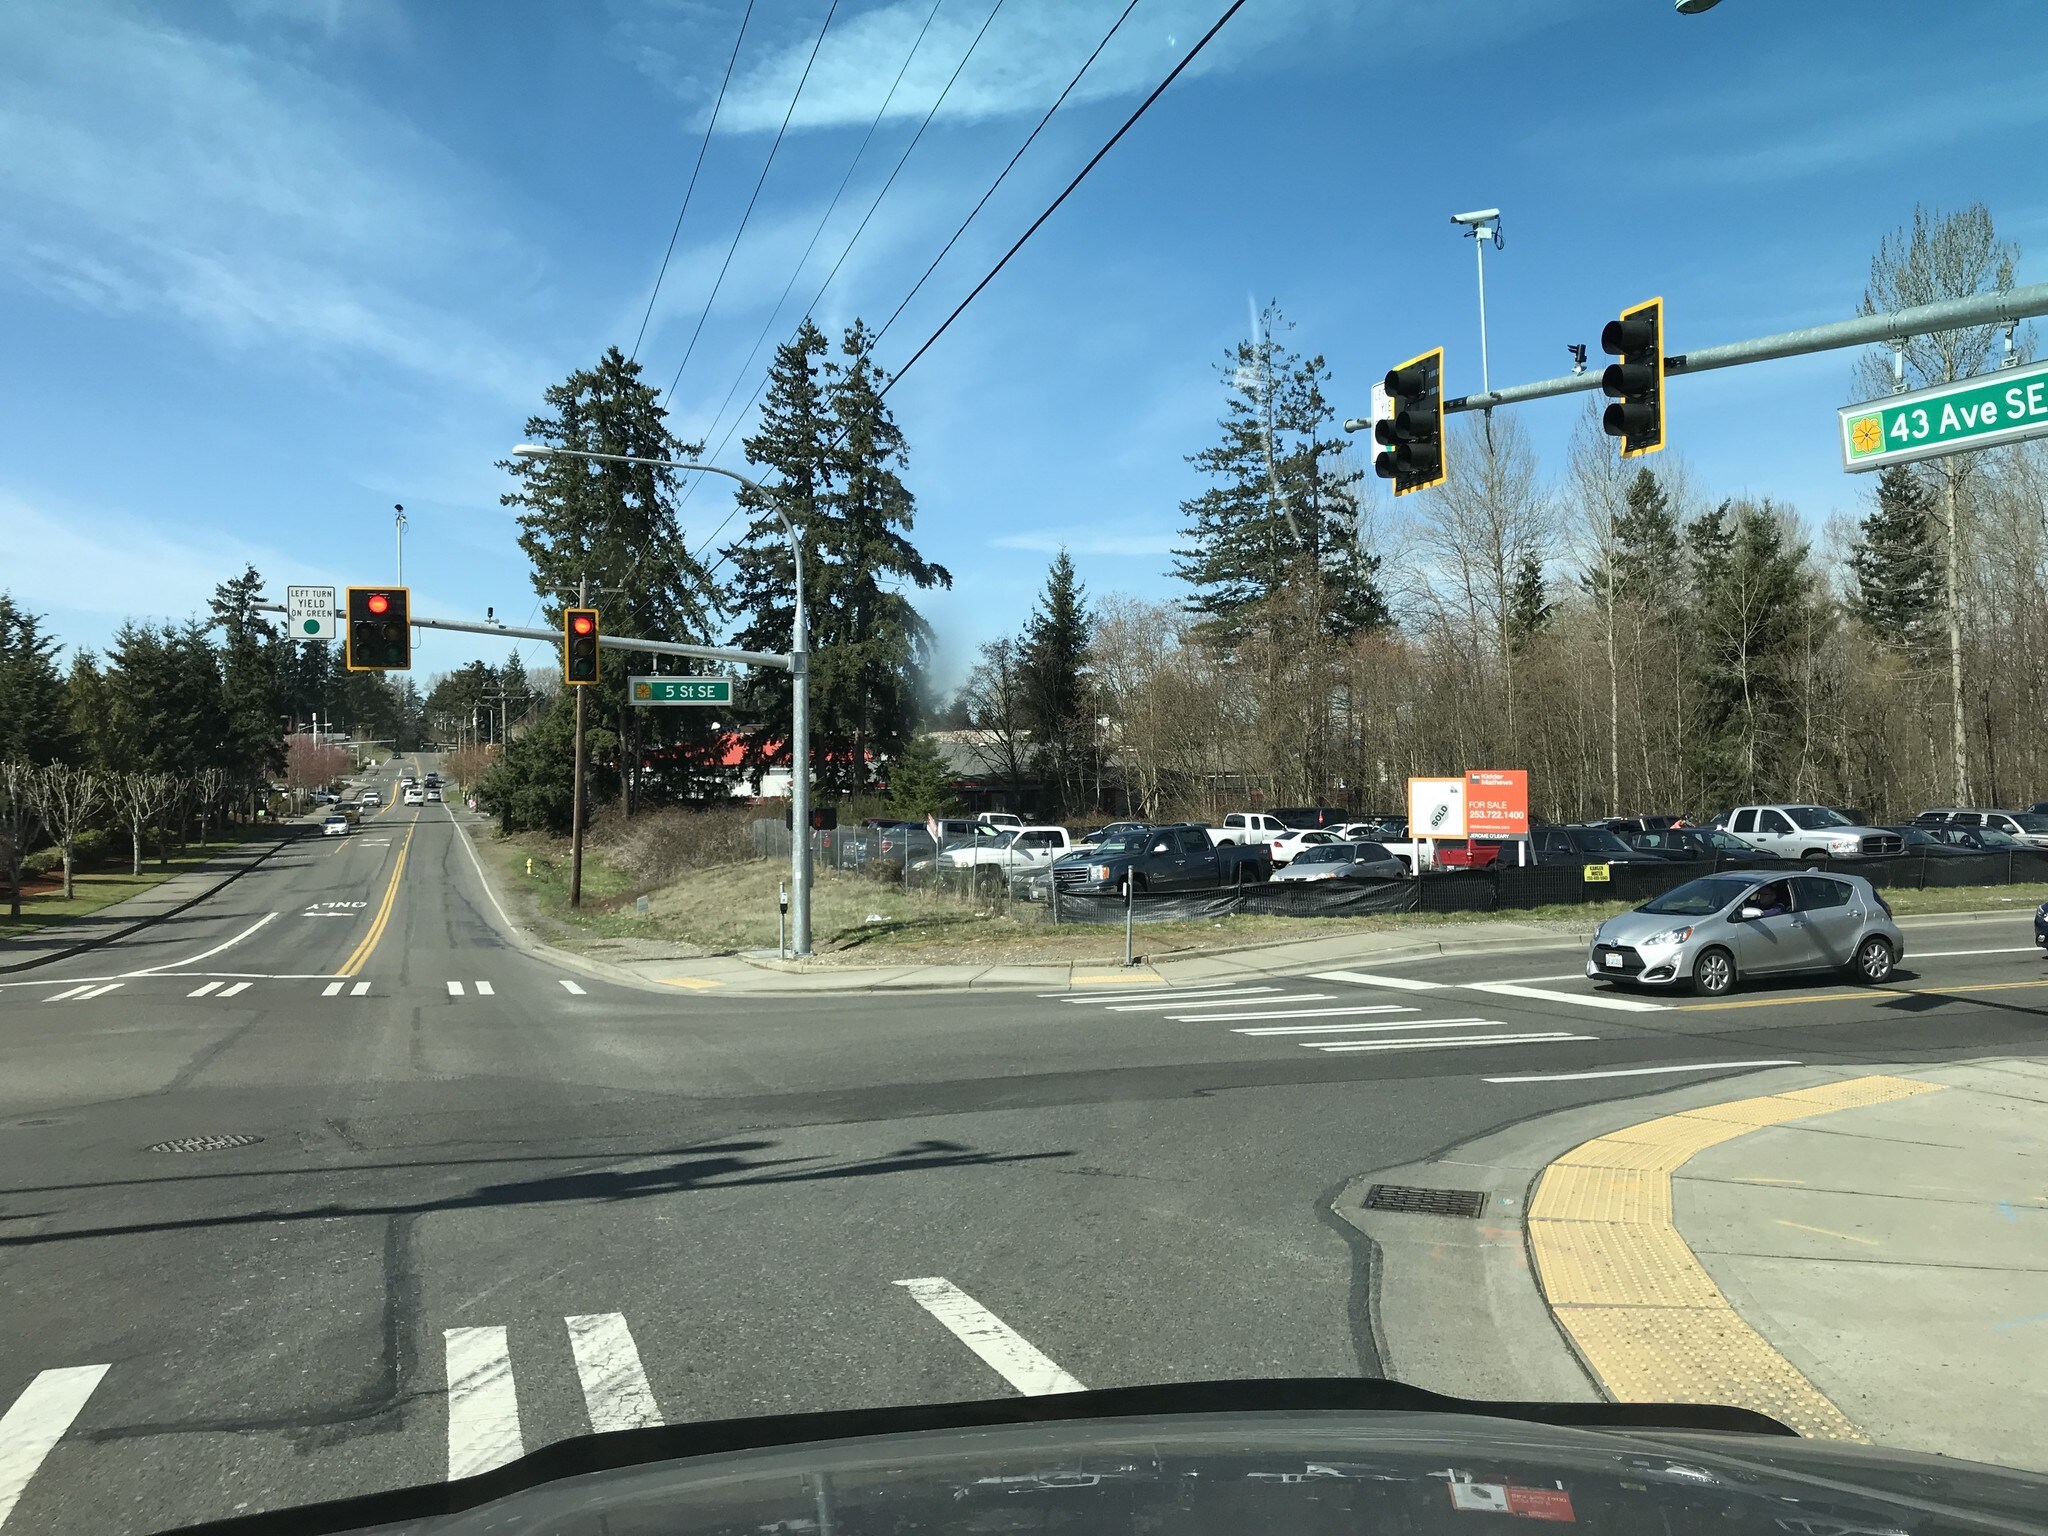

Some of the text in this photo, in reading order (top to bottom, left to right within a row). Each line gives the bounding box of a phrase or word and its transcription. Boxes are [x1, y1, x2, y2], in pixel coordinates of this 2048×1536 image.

[1890, 382, 2048, 442] 43 Ave SE
[298, 599, 325, 608] YIELD
[292, 609, 332, 617] ON GREEN
[665, 685, 715, 698] 5 St SE
[1487, 801, 1507, 809] SALE
[1431, 805, 1448, 827] SOLD
[1469, 810, 1525, 819] 253.722.1400
[305, 901, 368, 911] ONLY
